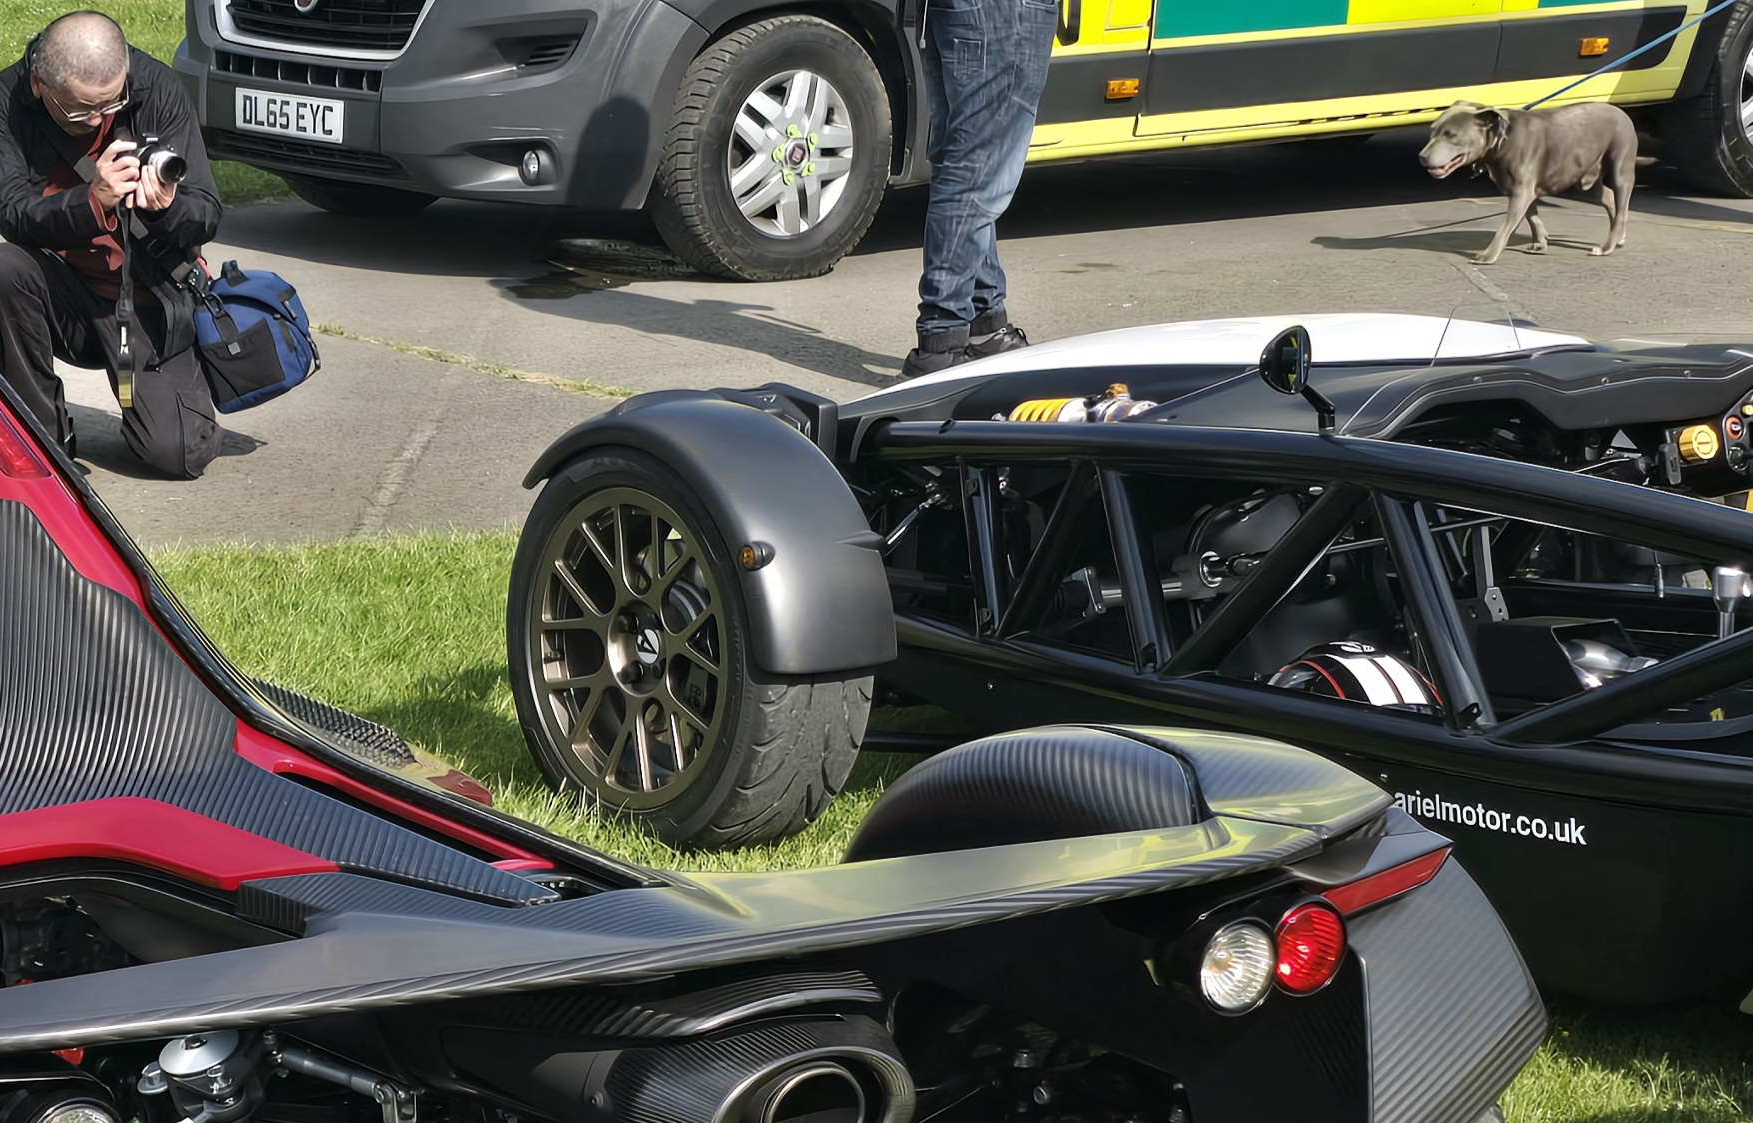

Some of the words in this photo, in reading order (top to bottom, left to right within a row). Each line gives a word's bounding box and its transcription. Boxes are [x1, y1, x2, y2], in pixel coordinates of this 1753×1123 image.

[243, 94, 290, 130] DL65
[296, 101, 334, 136] EYC
[1394, 789, 1588, 846] arielmotor.co.uk
